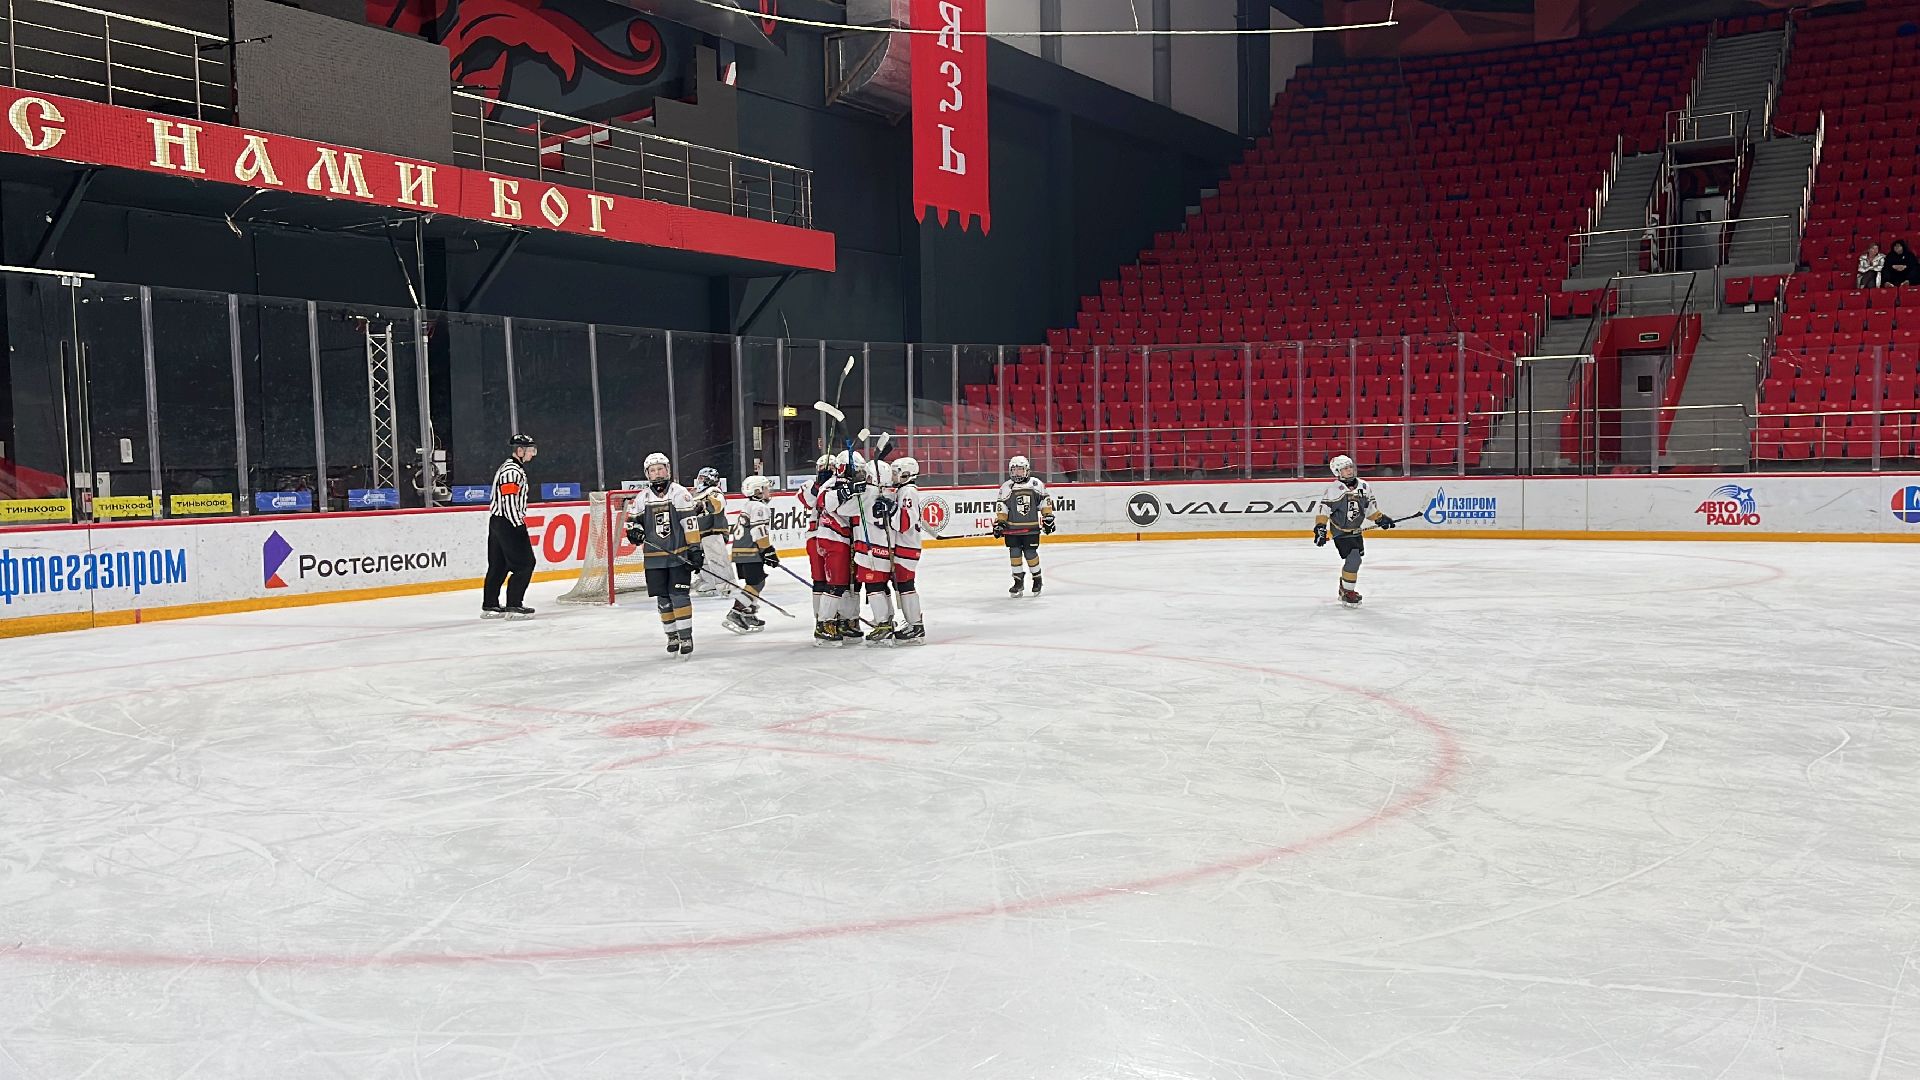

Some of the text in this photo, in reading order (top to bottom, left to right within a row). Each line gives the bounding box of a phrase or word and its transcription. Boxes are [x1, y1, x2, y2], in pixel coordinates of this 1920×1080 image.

[9, 97, 614, 233] С НАМИ БОГ
[6, 504, 66, 514] ТИНЬКОФФ
[176, 499, 228, 508] ТИНЬКОФФ
[1447, 497, 1497, 510] ГАЗПРОМ
[1694, 501, 1737, 513] АВТО
[1707, 514, 1760, 525] РАДИО
[299, 551, 447, 579] Ростелеком
